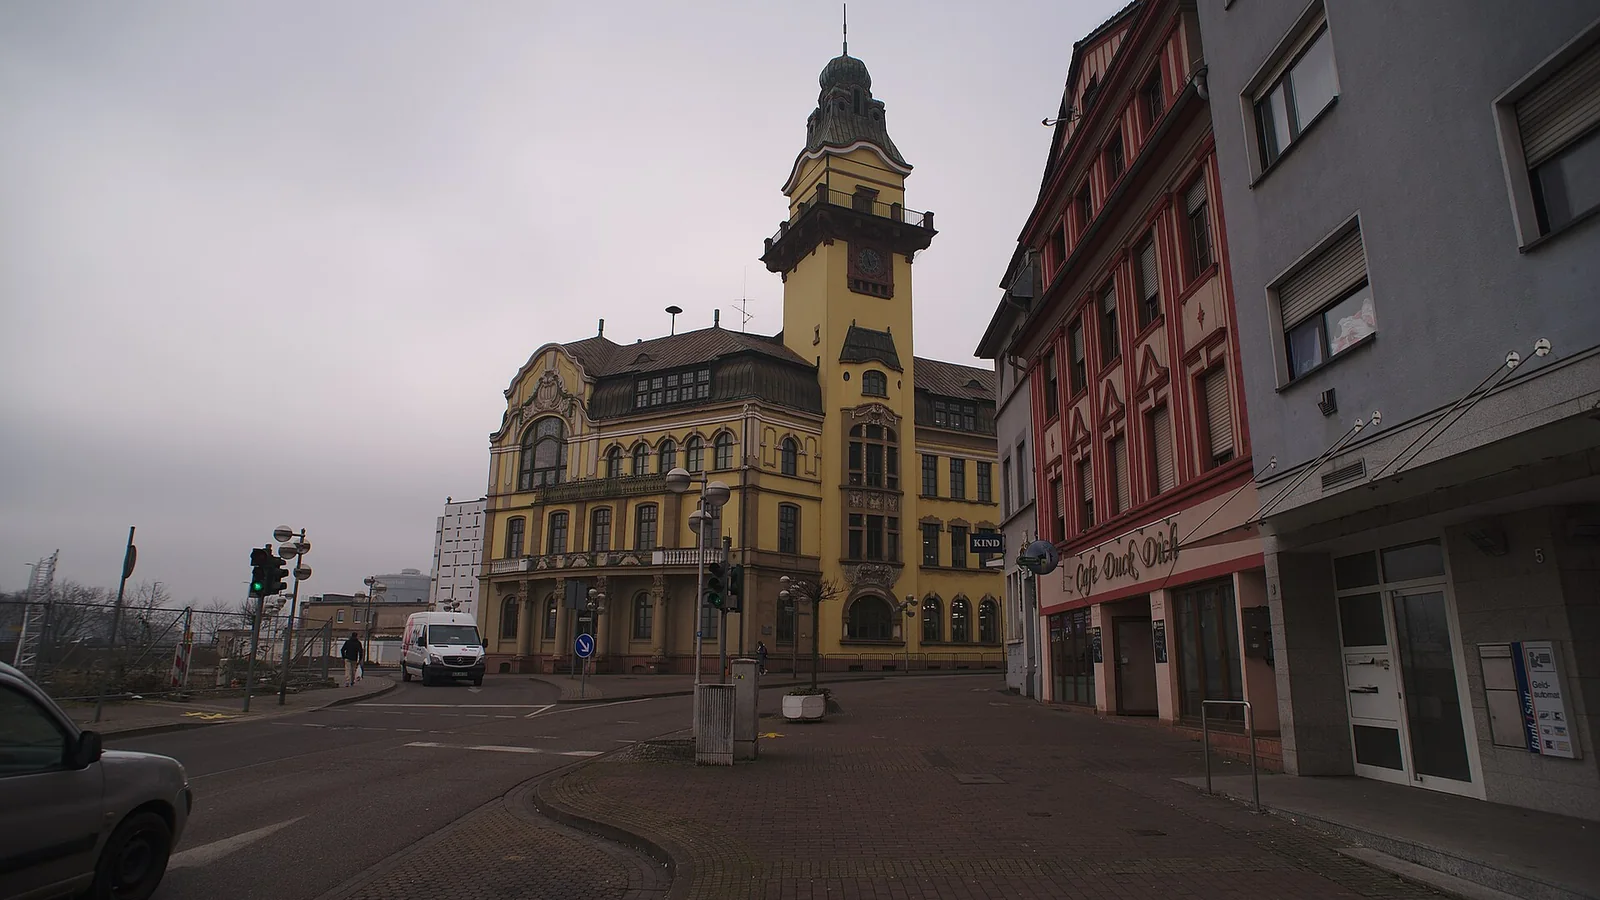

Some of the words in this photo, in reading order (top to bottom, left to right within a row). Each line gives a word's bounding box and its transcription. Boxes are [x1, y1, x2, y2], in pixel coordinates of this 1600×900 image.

[973, 539, 1000, 547] KIND
[1103, 539, 1139, 581] Duck
[1142, 522, 1180, 568] Dich
[1534, 548, 1545, 564] 5
[1532, 680, 1550, 688] Geld-
[1534, 691, 1560, 699] automat
